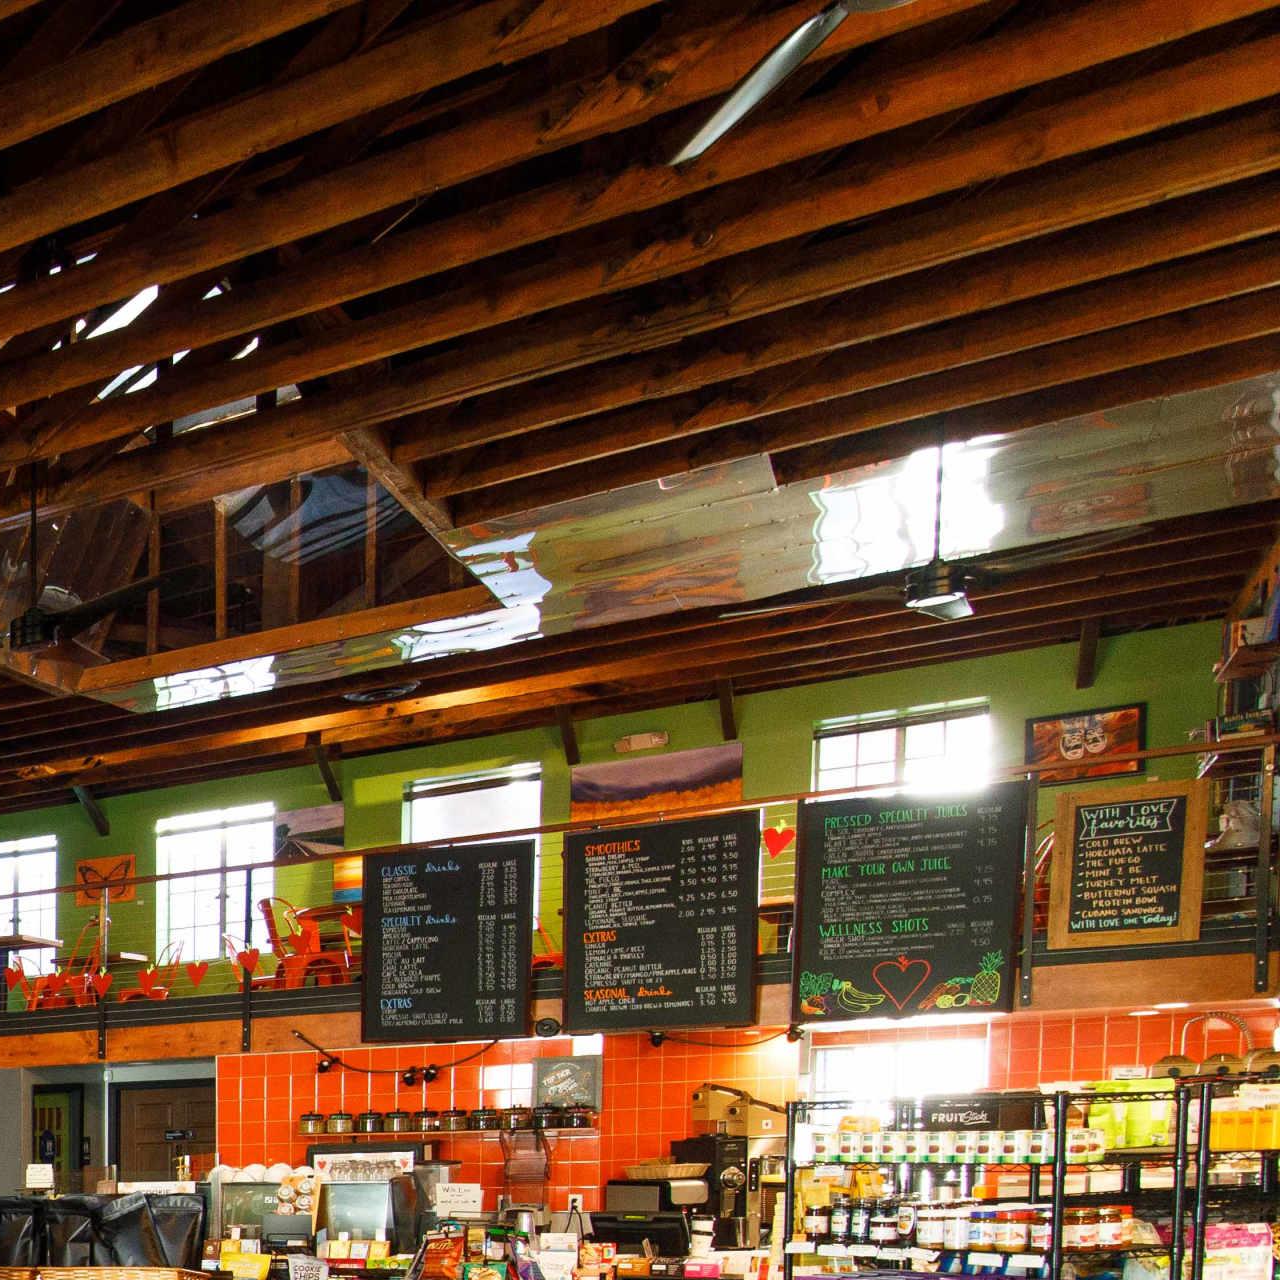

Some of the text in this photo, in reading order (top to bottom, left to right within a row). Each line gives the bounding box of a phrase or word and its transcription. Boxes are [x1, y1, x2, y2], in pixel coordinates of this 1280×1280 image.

[825, 804, 968, 830] PRESSED SPECIALTY JUICES
[1085, 803, 1169, 820] WITH LOVE
[1090, 815, 1160, 837] favorites
[585, 840, 640, 856] SMOOTHIES
[1086, 836, 1143, 849] COLD BREW
[1086, 844, 1168, 858] HORCHATA LATTE
[1109, 857, 1141, 865] FUEGO
[381, 865, 417, 877] CLASSIC
[425, 860, 460, 873] drinks
[822, 858, 951, 879] MAKE YOUR OWN JUICE
[1086, 866, 1142, 878] MINT 2 BE
[1086, 875, 1159, 889] TURKEY MELT
[1084, 885, 1176, 900] BUTTERNUT SQUASH
[1093, 898, 1133, 908] PROTEIN
[1082, 905, 1164, 919] CUBANO SANDWICH
[381, 916, 421, 927] SPECIALTY
[426, 914, 456, 925] drinks
[818, 918, 928, 937] WELLNESS SHOTS
[1071, 920, 1096, 930] WITH
[1099, 918, 1120, 928] LOVE
[584, 930, 616, 943] EXTRAS
[584, 988, 630, 1001] SEASONAL
[638, 986, 672, 997] drinks
[381, 998, 412, 1010] EXTRAS
[931, 1110, 990, 1125] FRUIT Sticks
[294, 1272, 320, 1280] CHIPS
